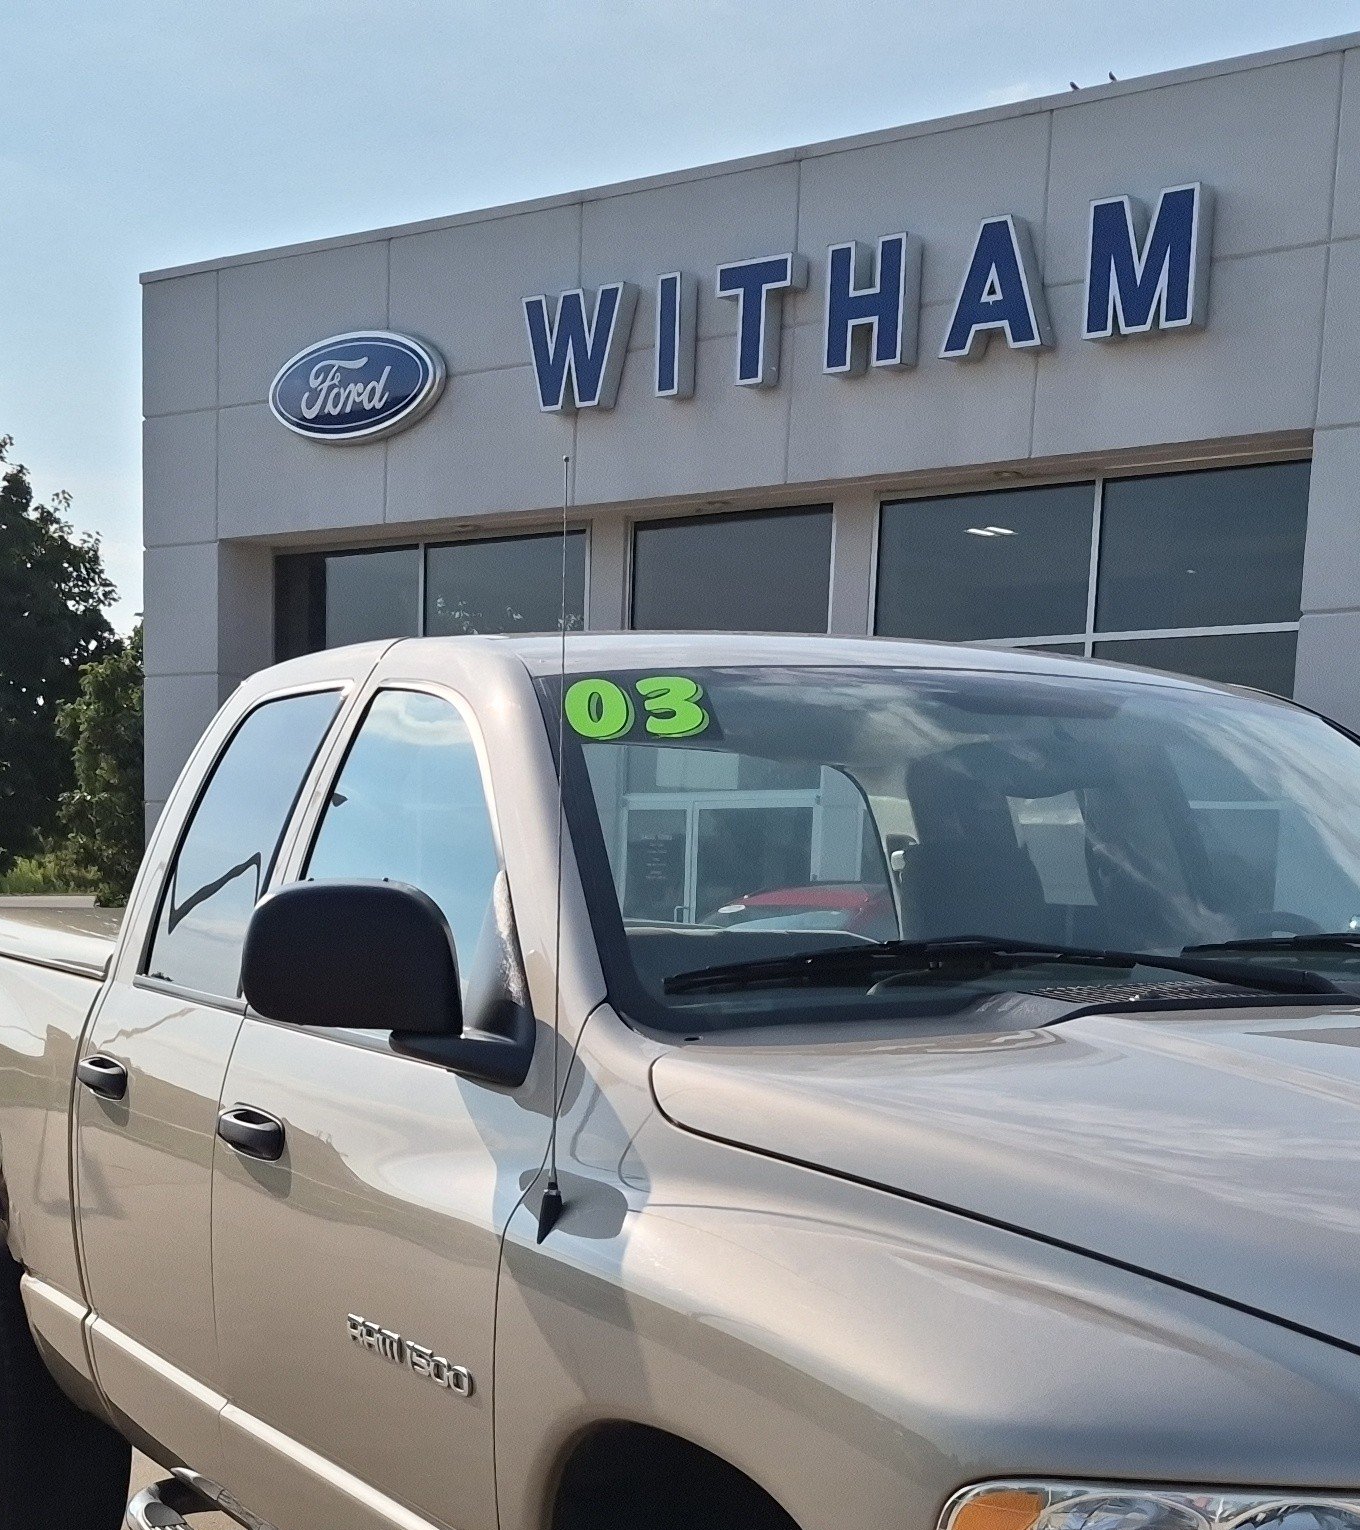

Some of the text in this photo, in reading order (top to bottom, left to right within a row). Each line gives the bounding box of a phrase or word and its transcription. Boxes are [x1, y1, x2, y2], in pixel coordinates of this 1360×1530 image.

[521, 181, 1208, 412] WITHAM
[301, 356, 392, 420] Ford
[565, 676, 710, 740] 03
[346, 1313, 474, 1397] RAM 1500
